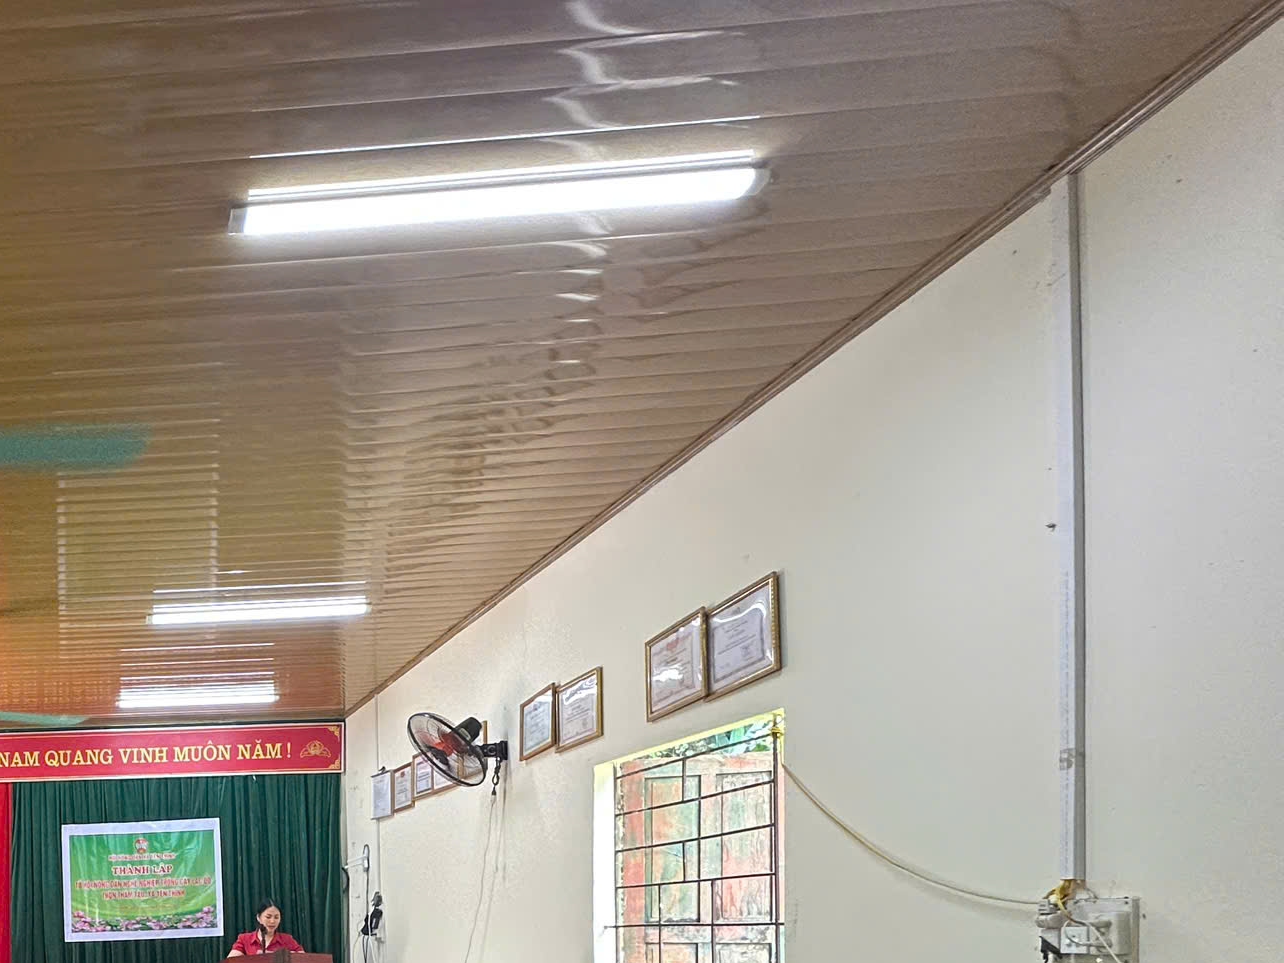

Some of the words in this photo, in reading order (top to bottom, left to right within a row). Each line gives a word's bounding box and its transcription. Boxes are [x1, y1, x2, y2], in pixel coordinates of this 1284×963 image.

[44, 749, 113, 767] QUANG
[118, 747, 169, 764] VINH
[173, 740, 231, 762] MUÔN
[237, 739, 282, 760] NĂM
[112, 863, 150, 875] THÀNH
[152, 861, 173, 875] LẬP
